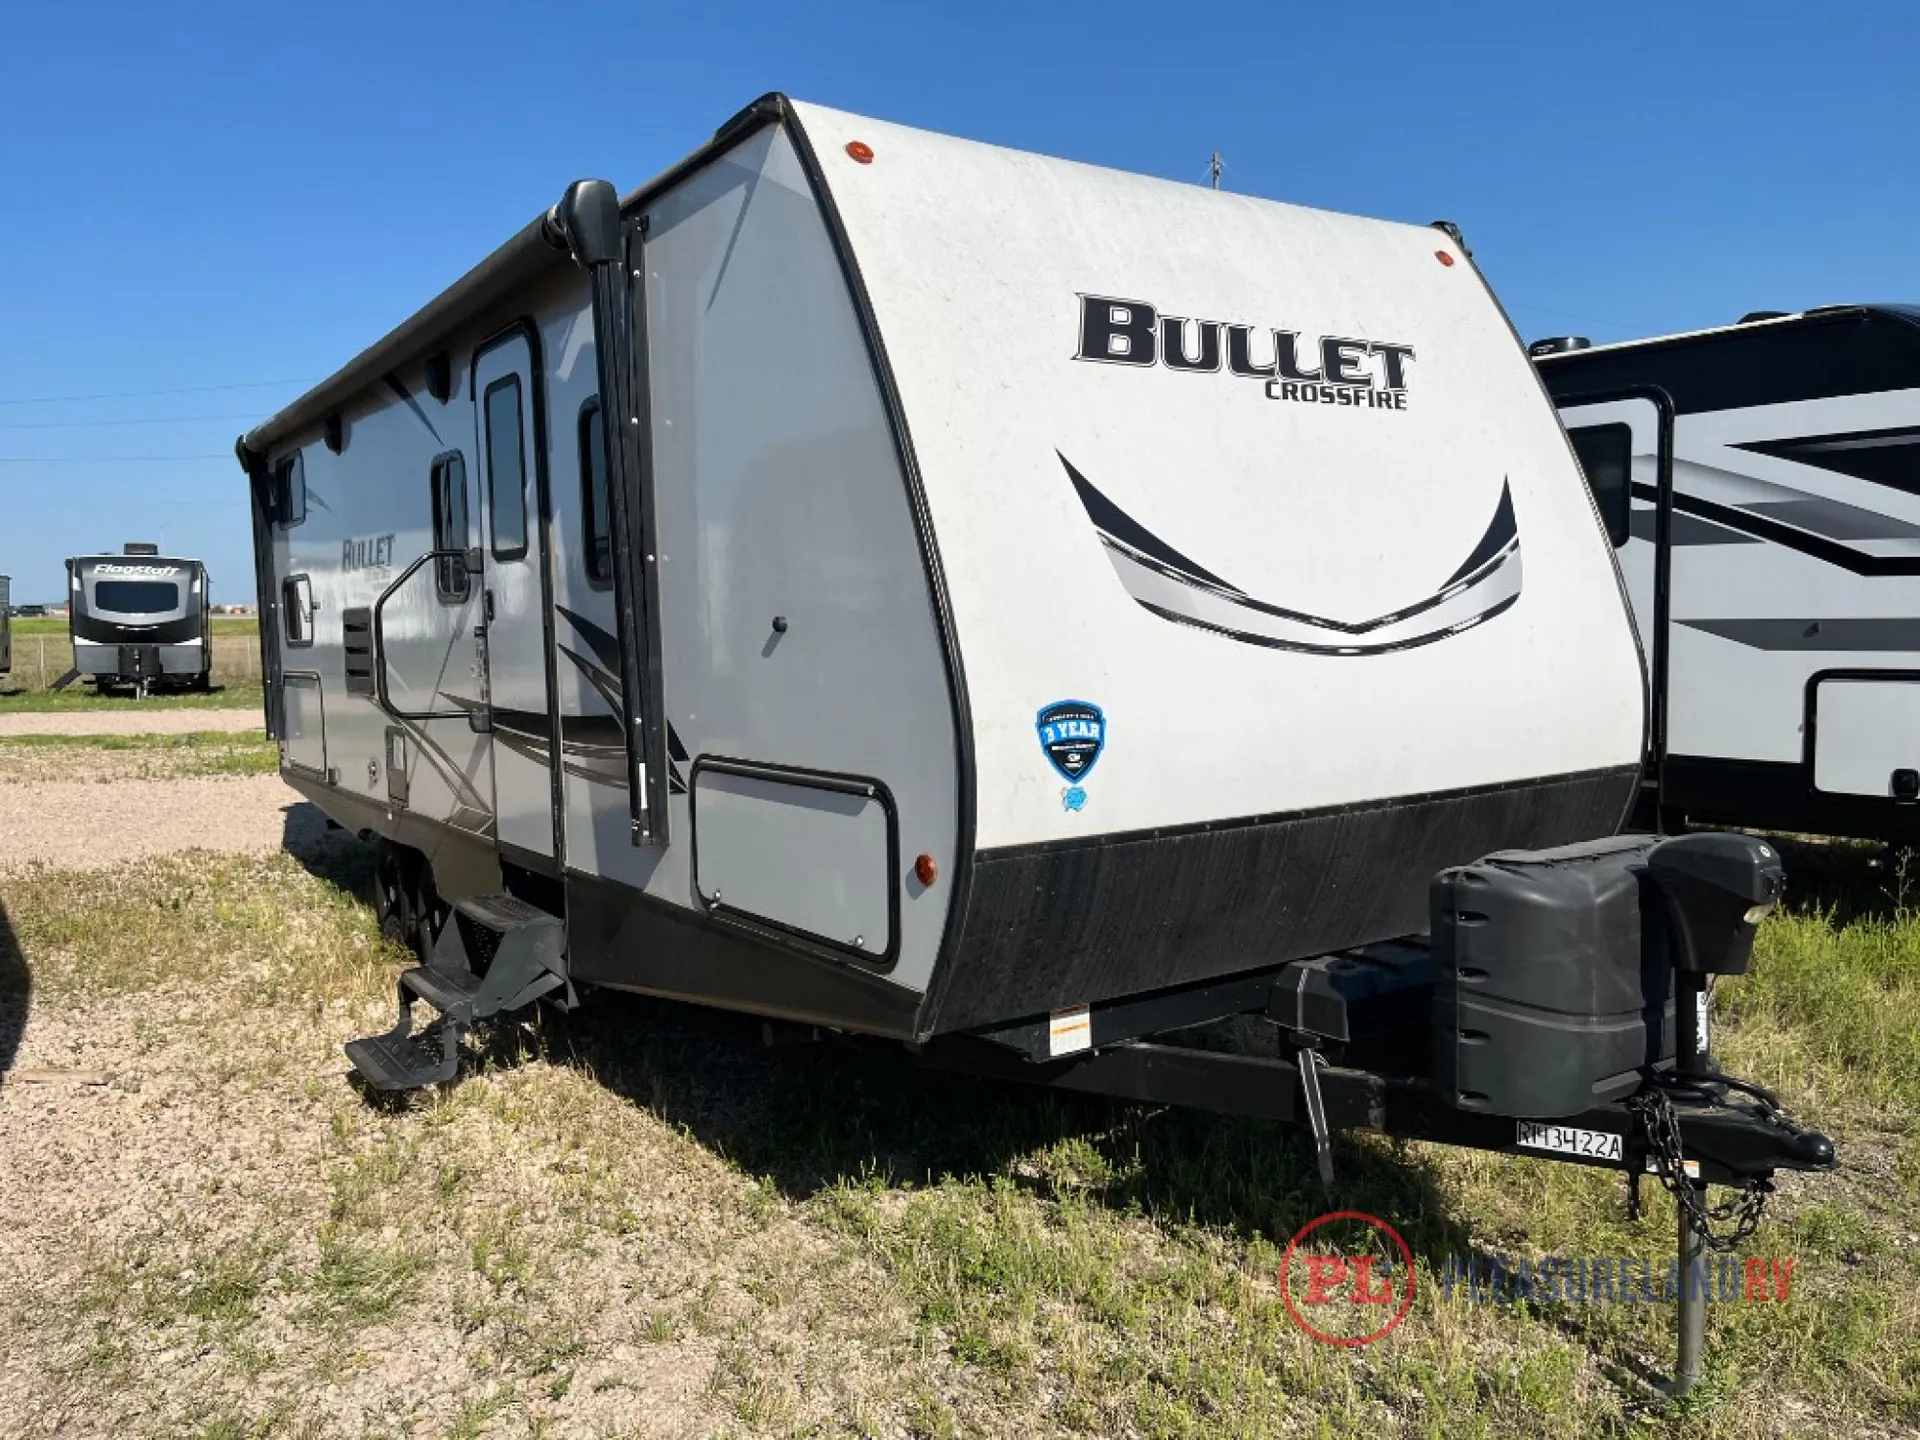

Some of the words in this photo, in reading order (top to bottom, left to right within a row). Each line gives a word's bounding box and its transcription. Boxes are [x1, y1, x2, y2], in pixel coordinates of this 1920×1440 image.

[1070, 291, 1416, 392] BULLET
[1265, 380, 1408, 411] CROSSFIRE
[93, 563, 180, 577] Flagstaff
[1057, 721, 1100, 739] YEAR
